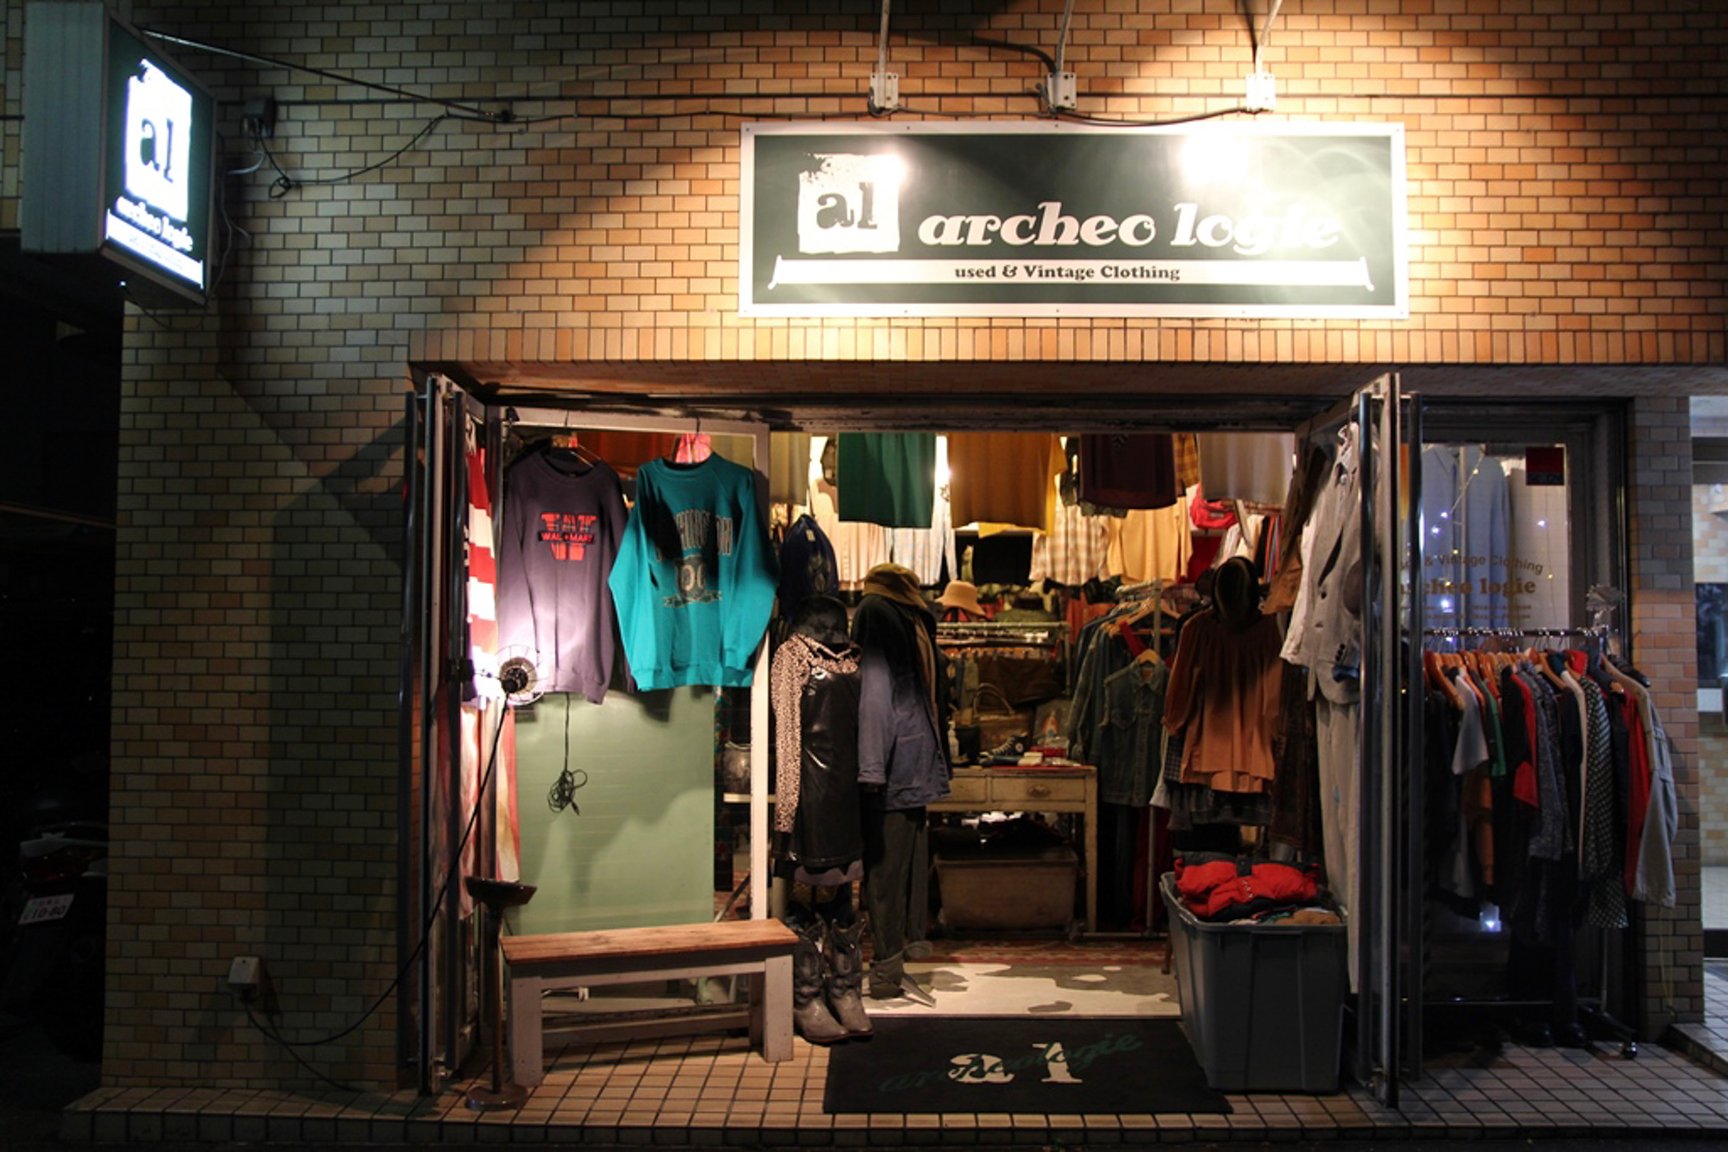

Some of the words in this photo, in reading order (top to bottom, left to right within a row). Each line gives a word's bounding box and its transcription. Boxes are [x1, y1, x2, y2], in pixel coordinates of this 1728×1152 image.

[140, 118, 173, 183] al
[816, 181, 878, 230] al
[917, 201, 1156, 246] archeo
[1170, 202, 1342, 256] logie
[954, 264, 997, 278] used
[1001, 264, 1018, 279] &
[1023, 264, 1096, 281] Vintage
[1100, 264, 1181, 281] Clothing
[1438, 555, 1486, 567] Vintage
[1491, 555, 1544, 576] Clothing
[1479, 577, 1536, 597] logie
